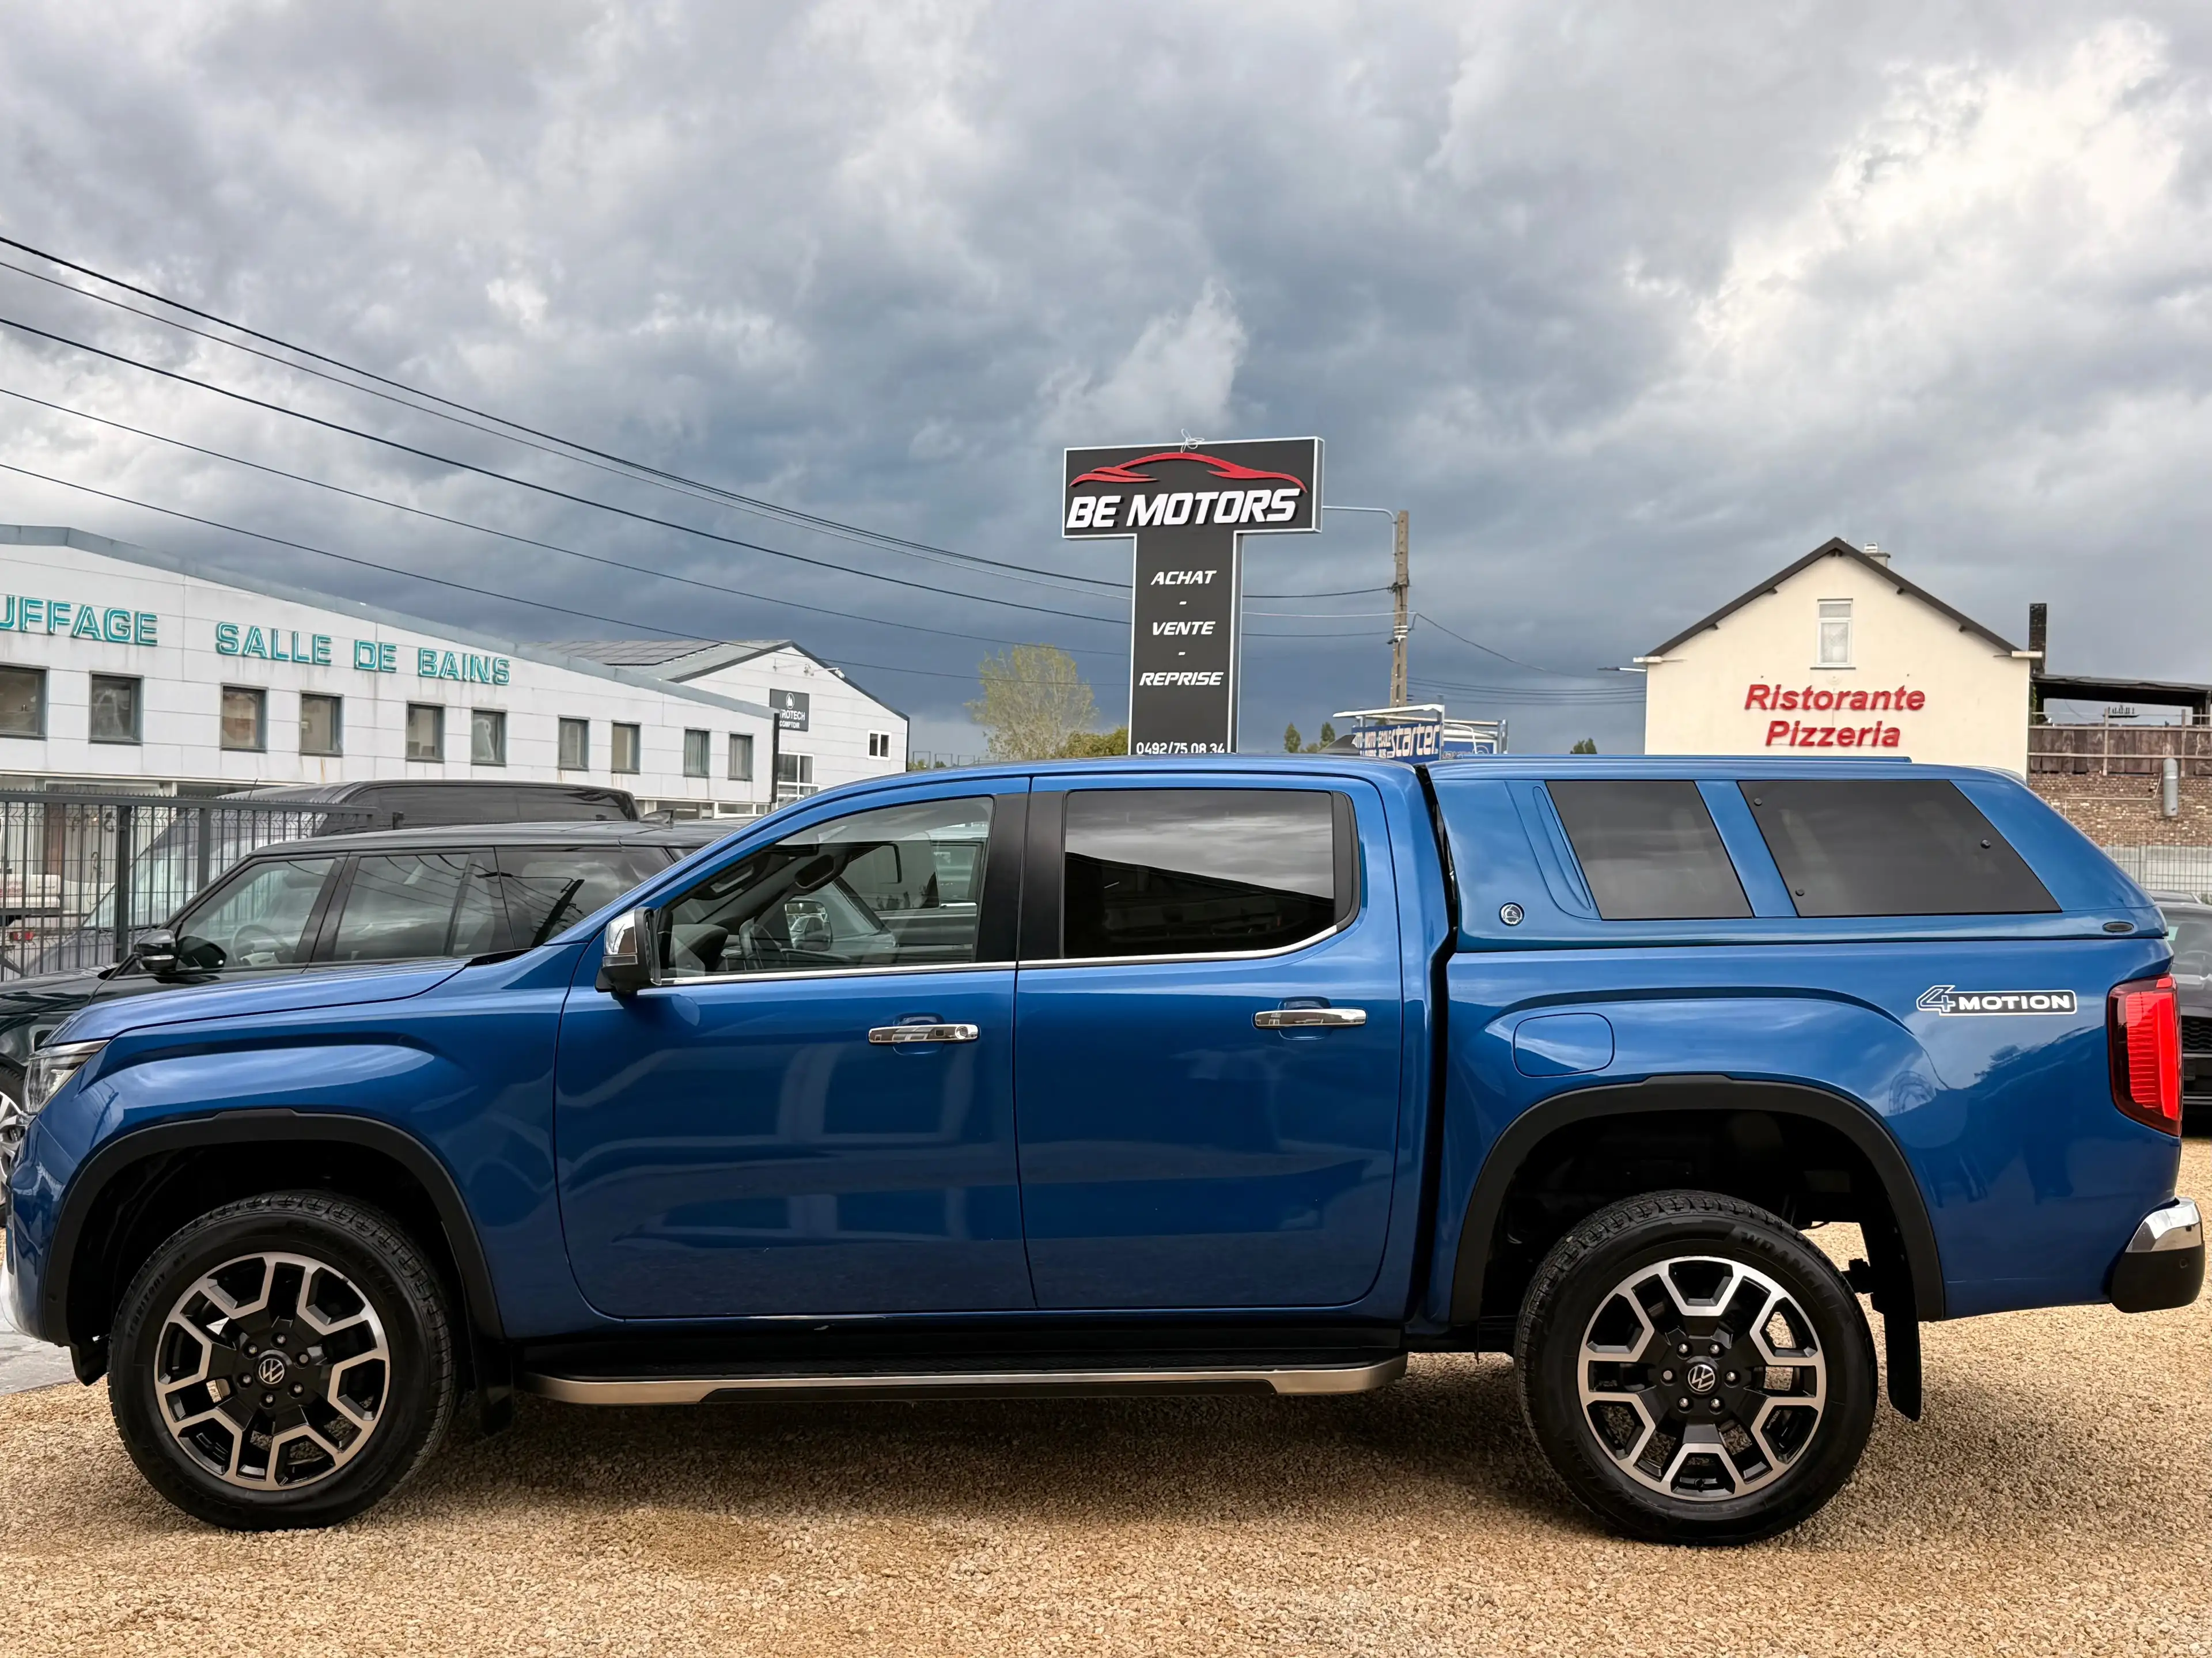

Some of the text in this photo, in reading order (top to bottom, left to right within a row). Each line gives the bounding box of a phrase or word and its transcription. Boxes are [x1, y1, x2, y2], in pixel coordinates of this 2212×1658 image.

[1066, 488, 1301, 529] BE MOTORS
[1150, 570, 1217, 585] ACHAT
[1153, 621, 1216, 635] VENTE
[215, 622, 332, 666] SALLE
[353, 639, 397, 673] DE
[417, 647, 511, 685] BAINS
[1139, 671, 1224, 686] REPRISE
[1744, 684, 1926, 711] Ristorante
[1765, 720, 1901, 747] Pizzeria
